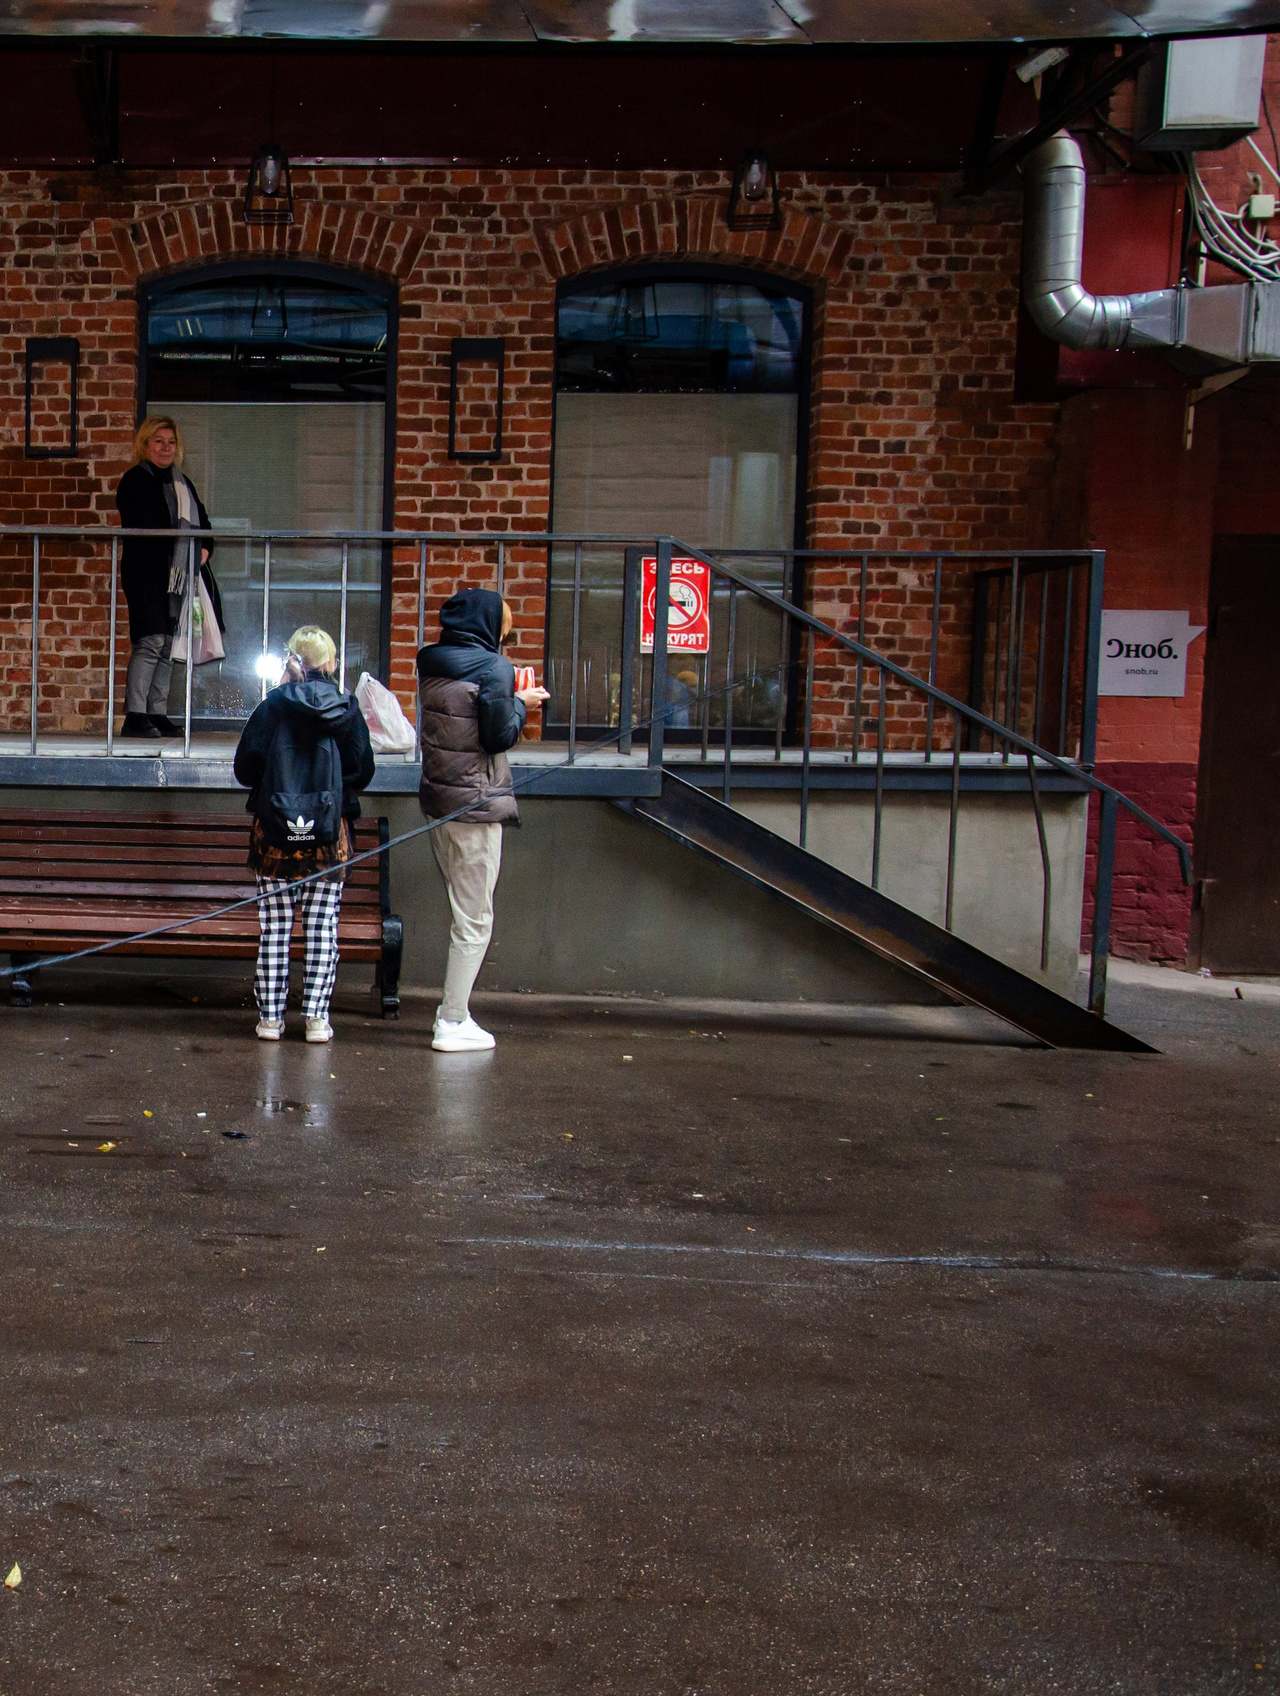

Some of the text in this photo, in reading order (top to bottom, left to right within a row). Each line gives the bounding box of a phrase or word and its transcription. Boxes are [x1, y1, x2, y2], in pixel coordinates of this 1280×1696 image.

[649, 562, 705, 575] ЗЕСЬ
[1125, 667, 1159, 676] snob.ru
[287, 834, 316, 842] adidas
